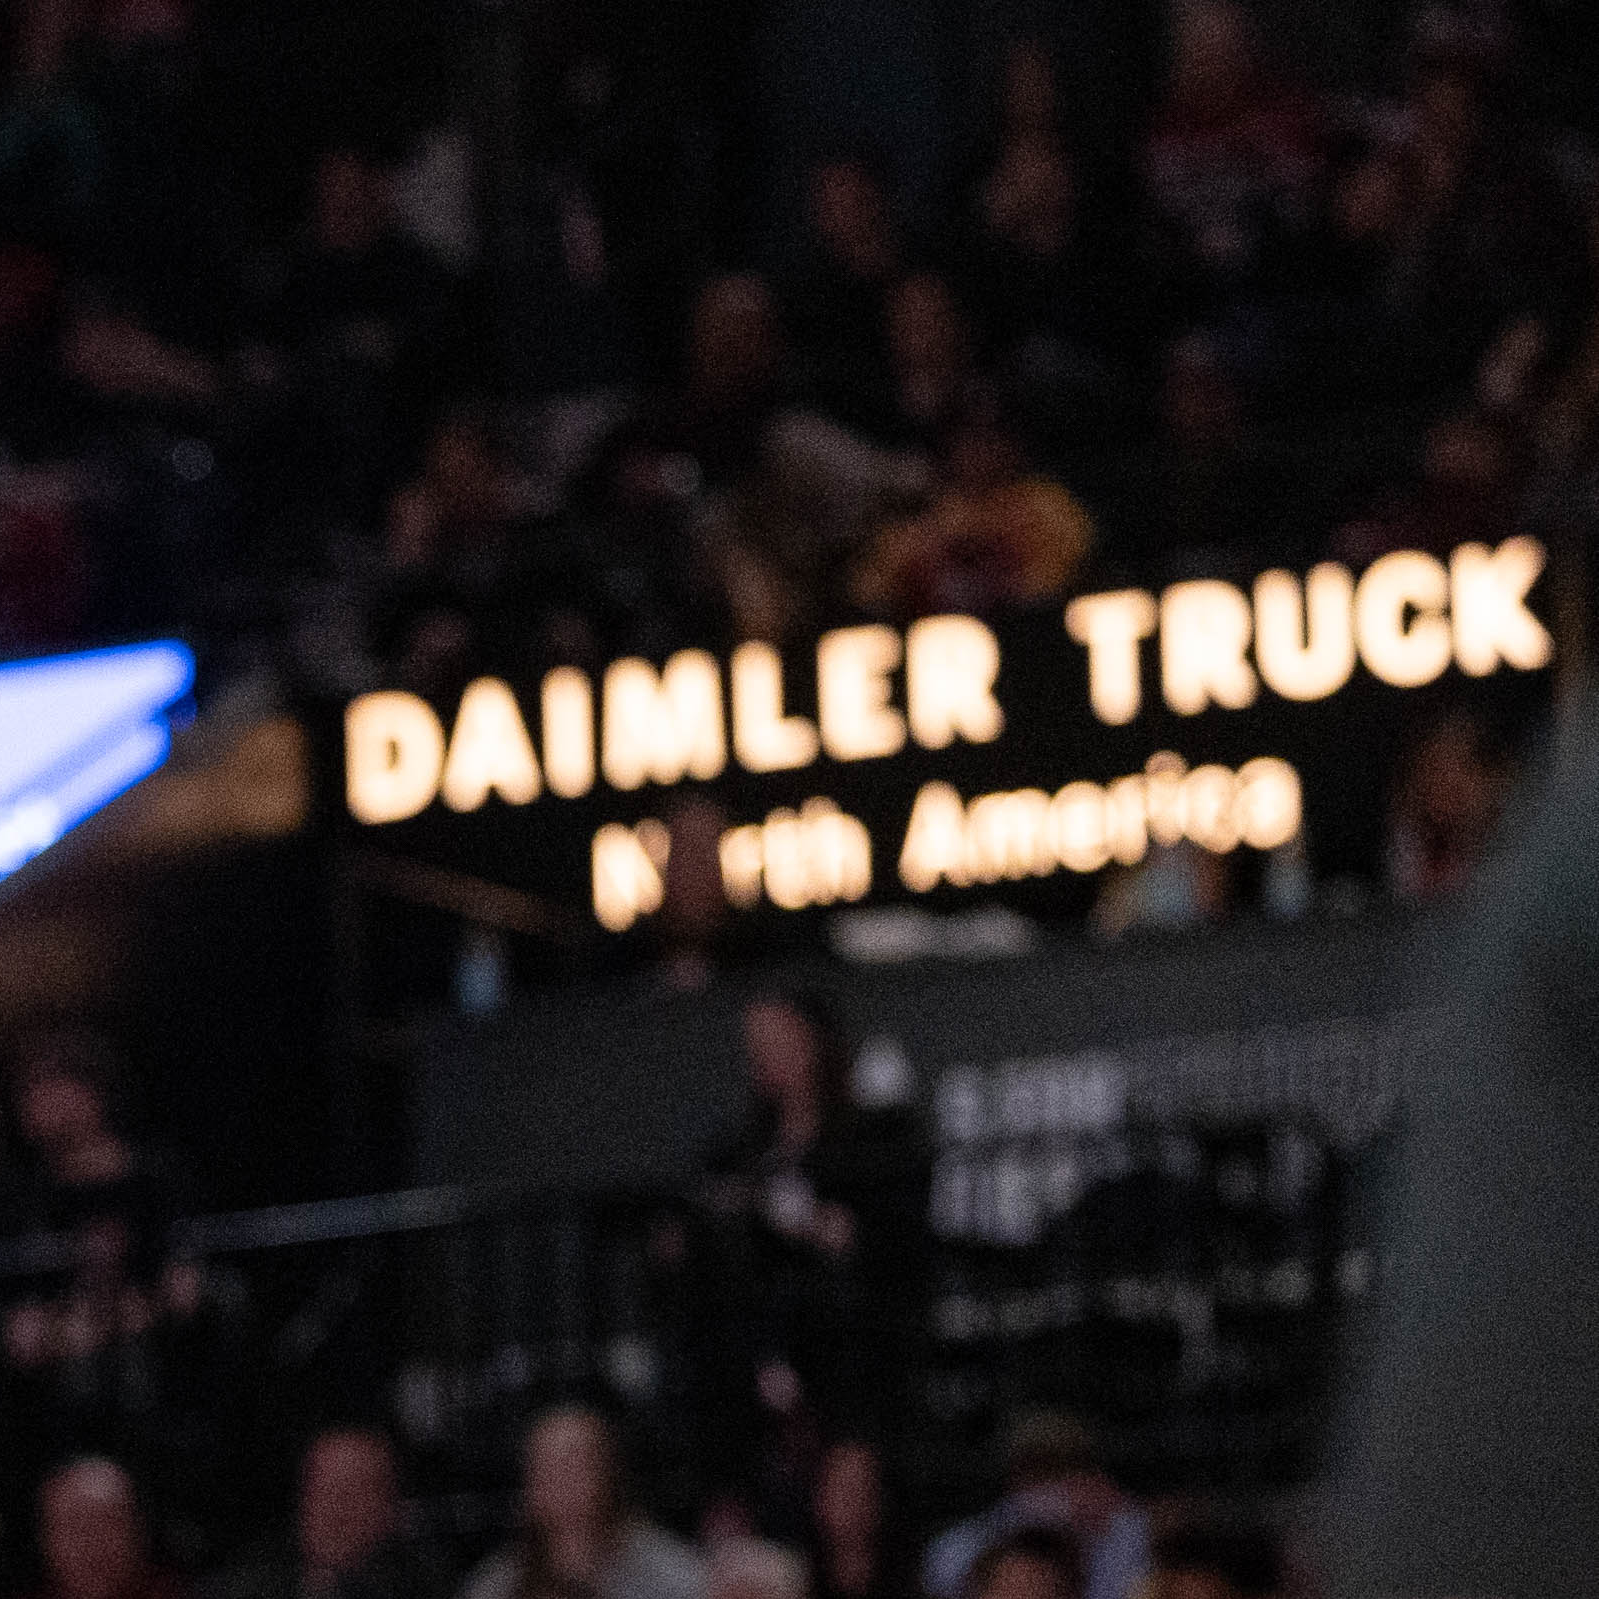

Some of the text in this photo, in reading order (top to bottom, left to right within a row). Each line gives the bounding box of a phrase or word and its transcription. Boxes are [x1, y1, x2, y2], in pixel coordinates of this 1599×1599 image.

[344, 534, 1554, 825] DAIMLER TRUCK
[591, 750, 1304, 932] Nrth America
